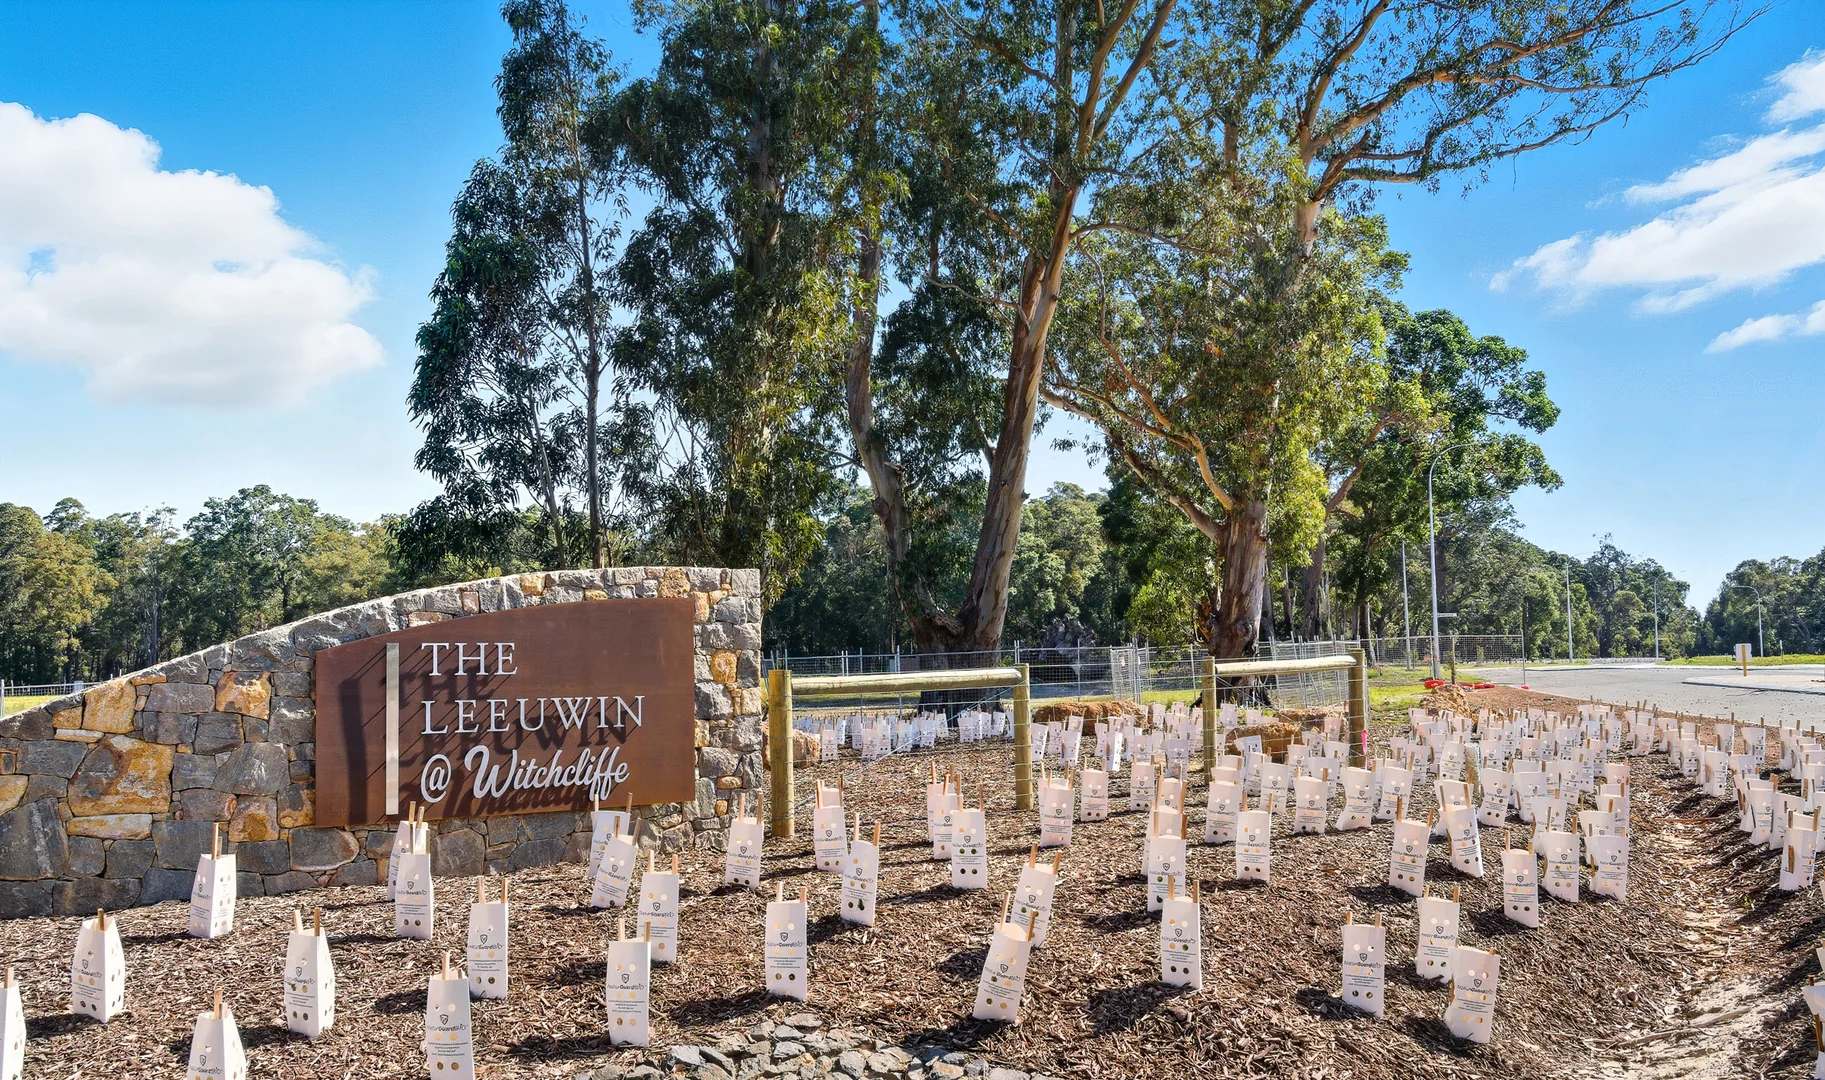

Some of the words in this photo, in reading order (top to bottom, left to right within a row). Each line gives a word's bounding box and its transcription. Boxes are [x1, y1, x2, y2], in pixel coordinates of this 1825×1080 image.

[421, 642, 518, 676] THE
[421, 695, 645, 735] LEEUWIN
[420, 754, 452, 803] @
[464, 744, 630, 802] Witchcliffe
